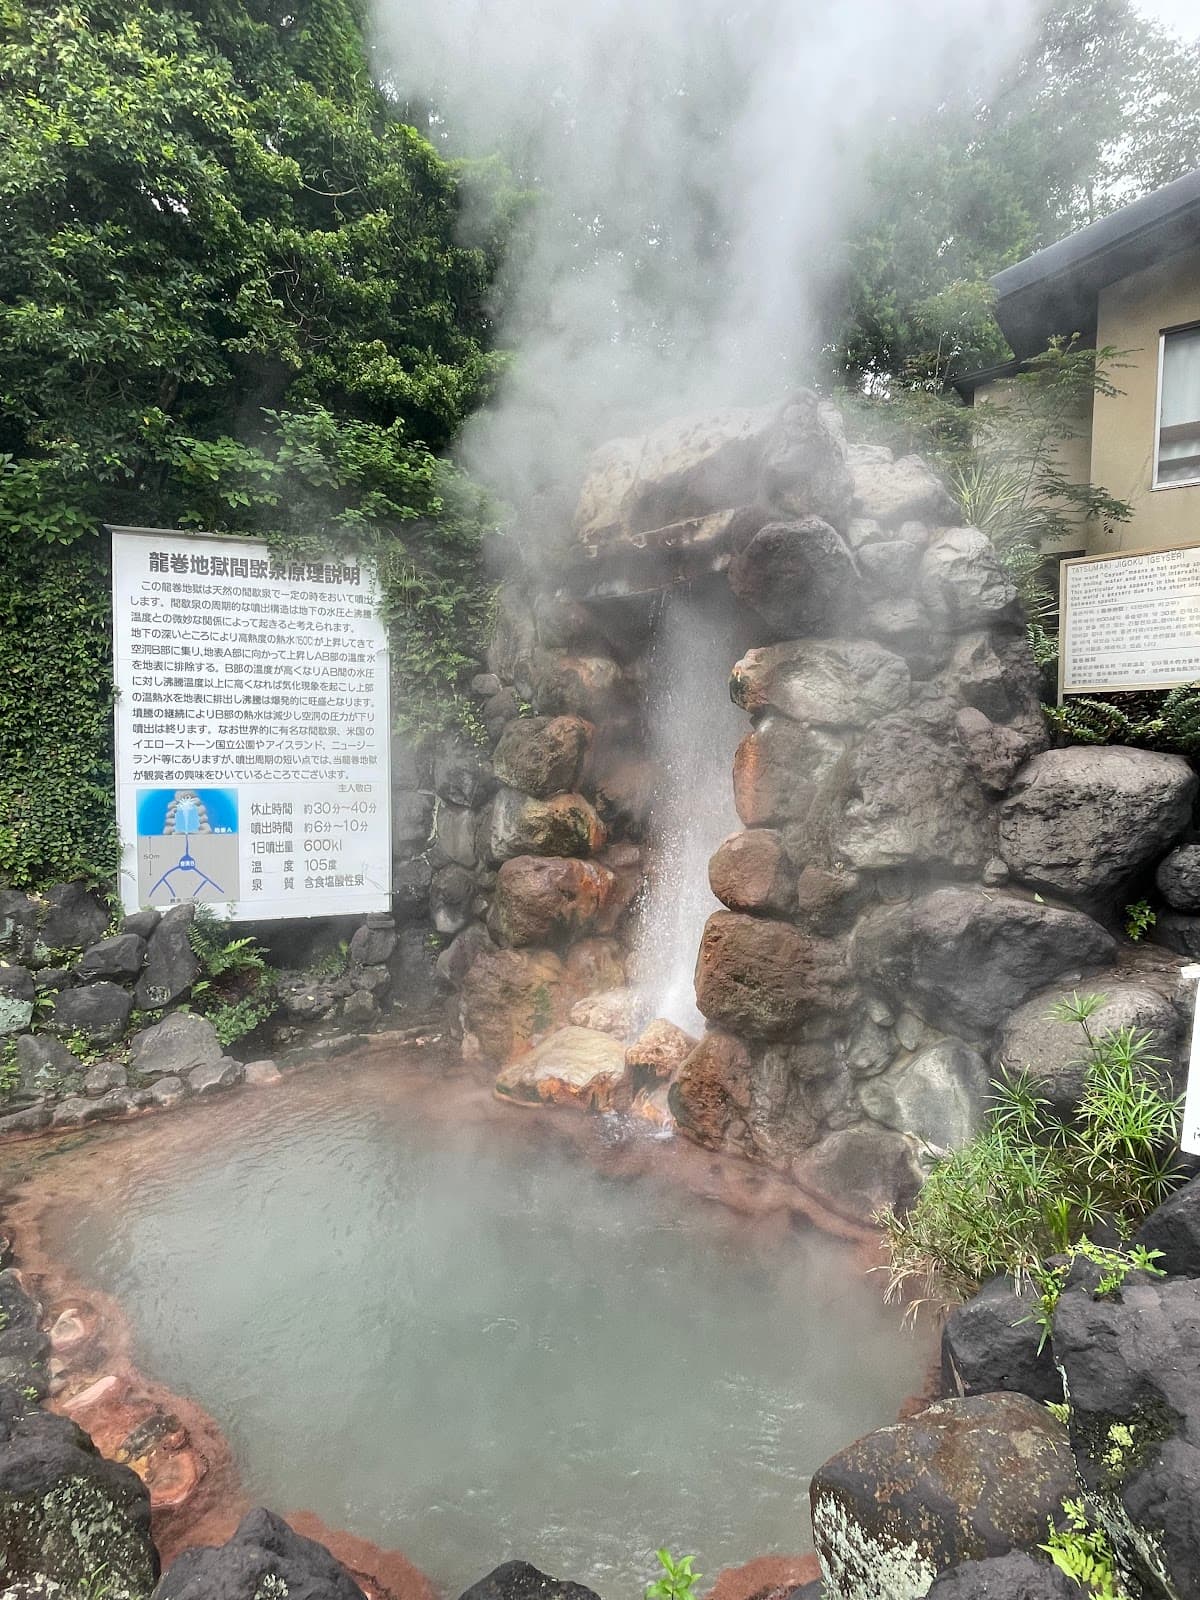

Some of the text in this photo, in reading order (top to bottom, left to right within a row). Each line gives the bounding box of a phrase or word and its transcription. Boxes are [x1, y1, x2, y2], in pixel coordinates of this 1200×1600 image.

[1071, 562, 1112, 573] TATSUMAKI
[1115, 557, 1144, 570] JIGOKU
[250, 802, 293, 816] 休止時間
[250, 820, 293, 835] 噴出時間
[251, 840, 294, 855] 1日噴出量
[304, 858, 337, 872] 105度
[303, 874, 365, 889] 含食塩酸性泉
